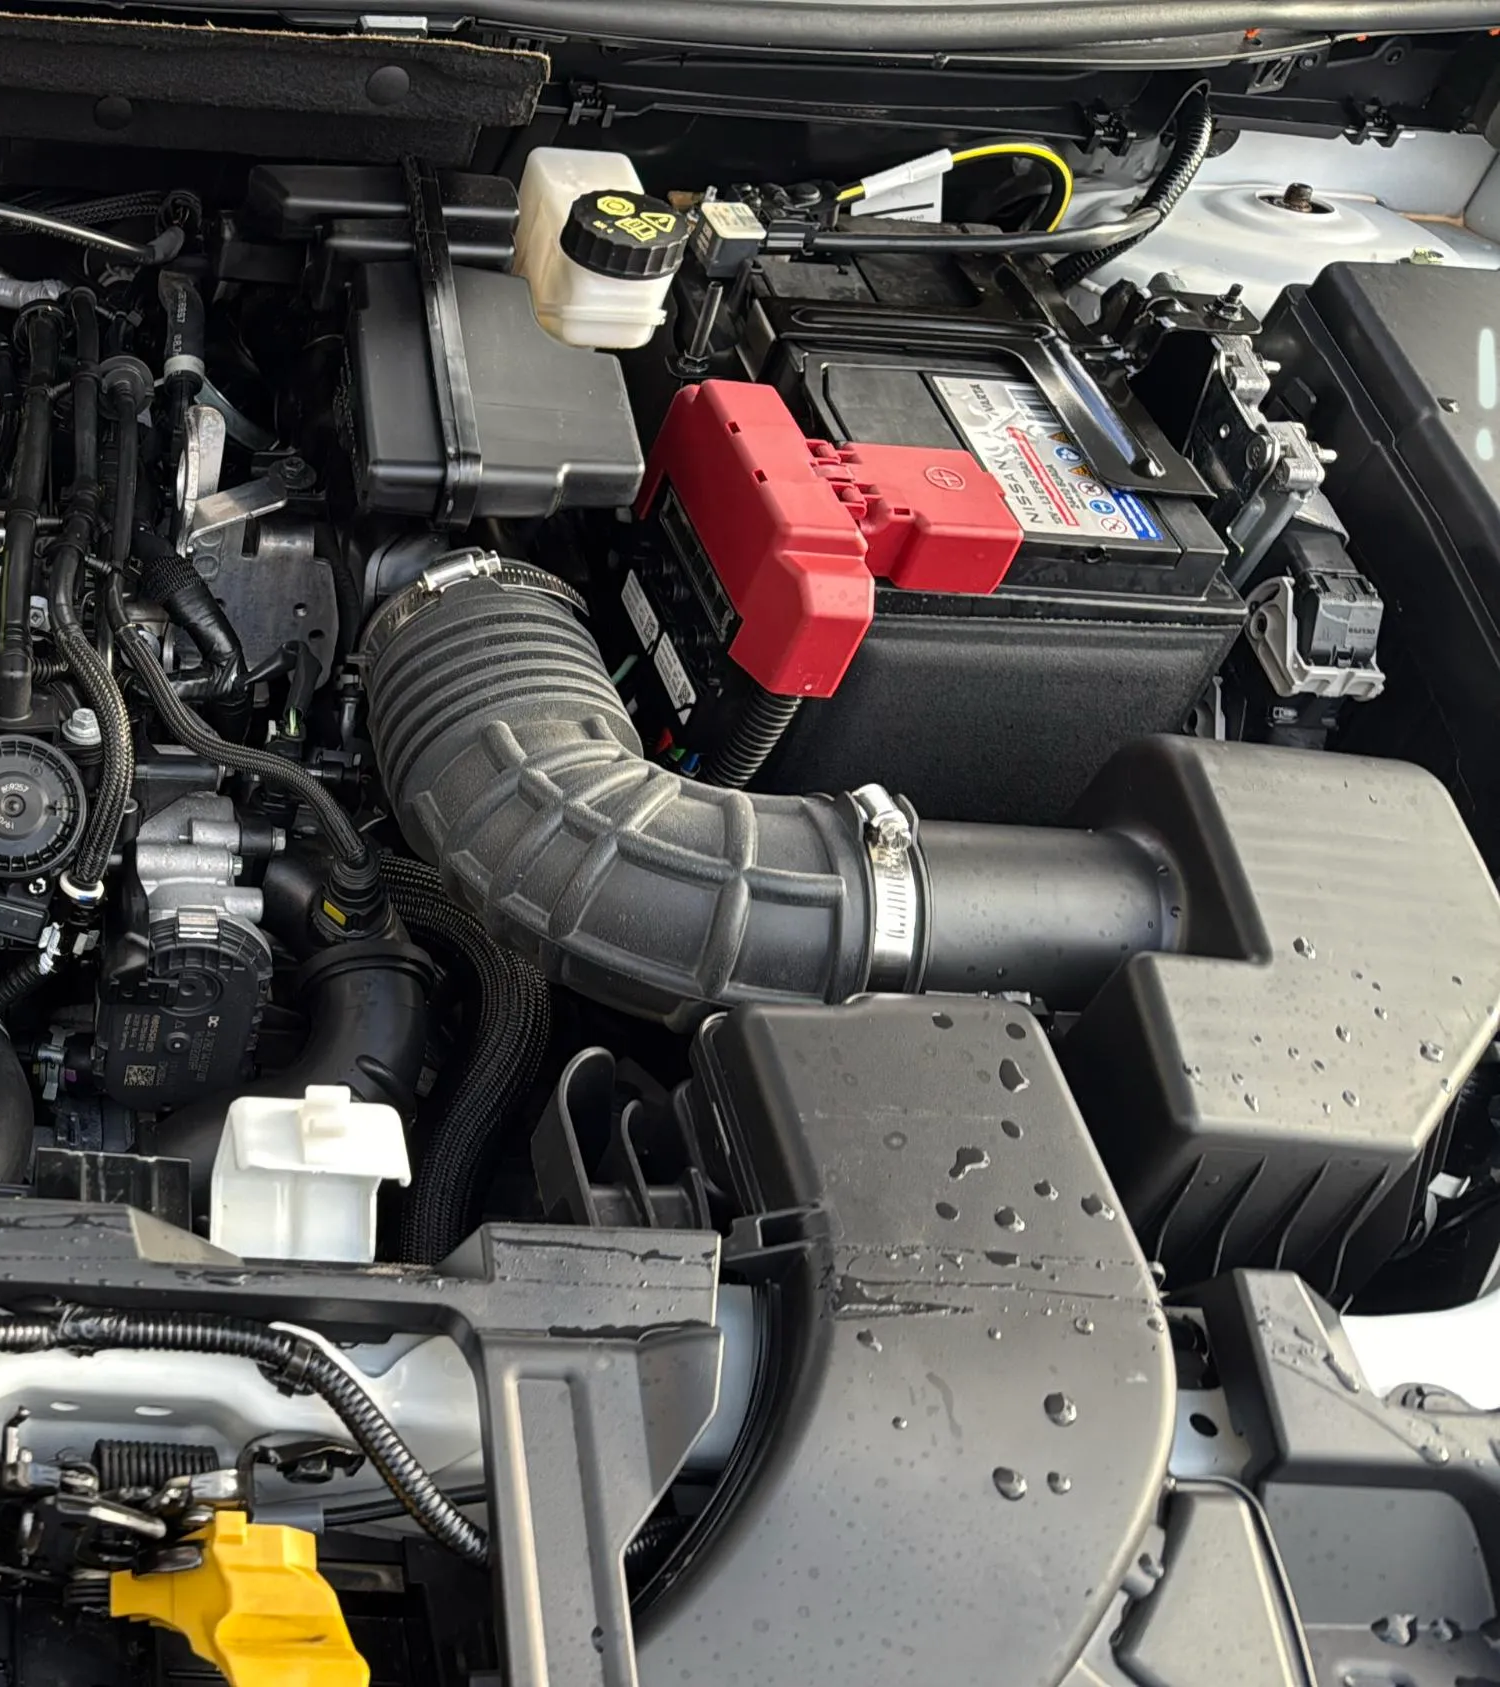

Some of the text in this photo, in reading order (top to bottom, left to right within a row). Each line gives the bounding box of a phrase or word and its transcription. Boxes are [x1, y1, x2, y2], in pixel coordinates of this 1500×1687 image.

[969, 383, 995, 412] VARTA
[994, 459, 1044, 524] NISSAN
[207, 1016, 220, 1028] DC
